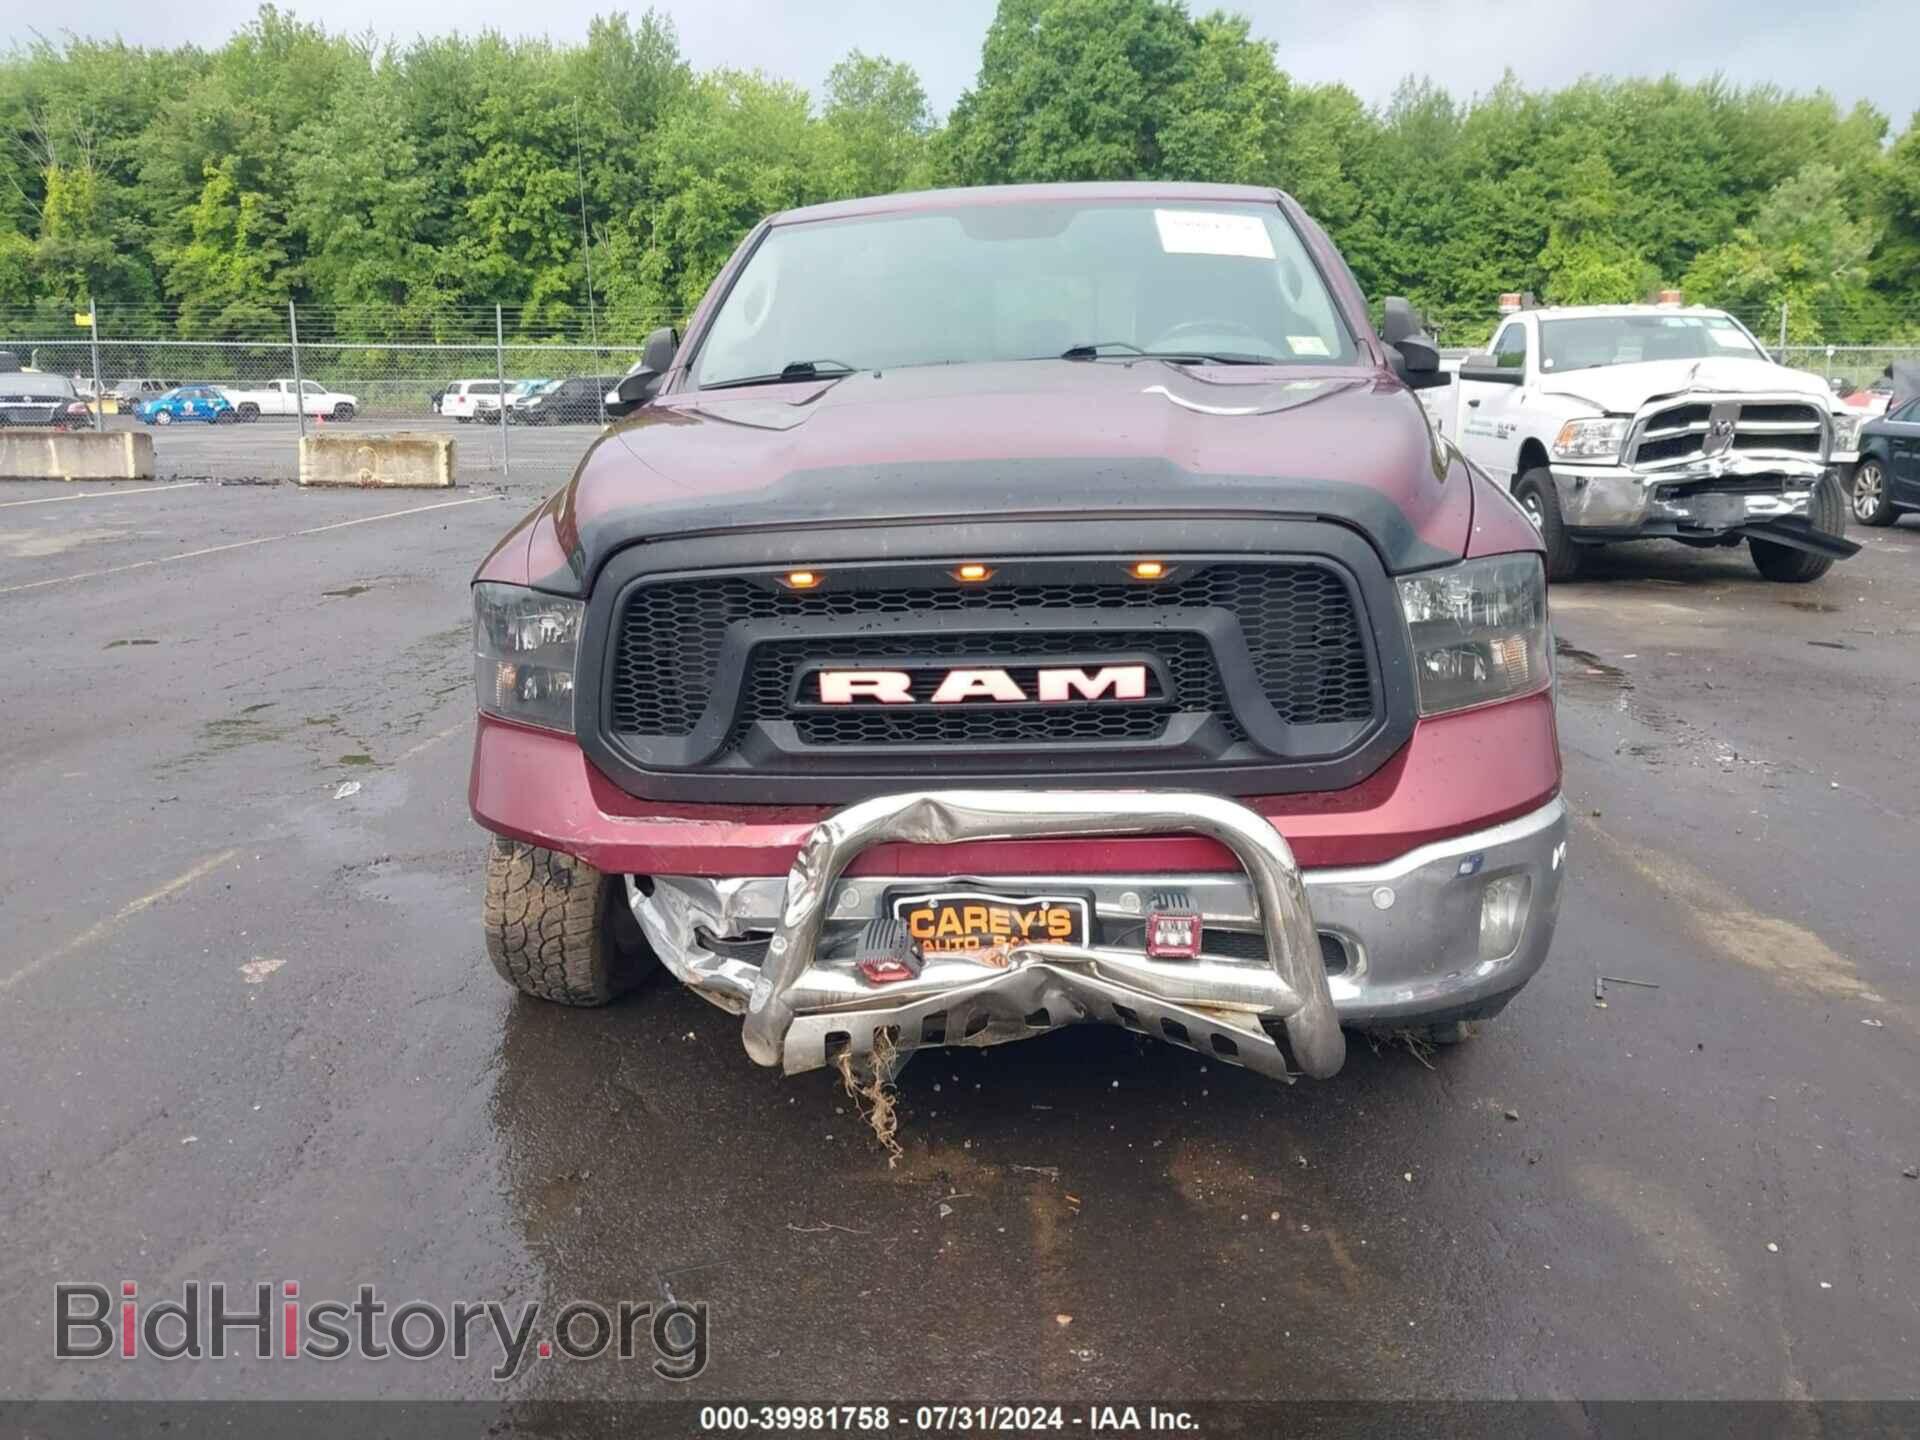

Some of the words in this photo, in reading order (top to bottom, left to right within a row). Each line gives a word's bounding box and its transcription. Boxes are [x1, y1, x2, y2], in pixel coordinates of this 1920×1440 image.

[818, 665, 1147, 704] RAM
[910, 905, 1072, 938] CAREY'S
[922, 935, 980, 952] AUTO
